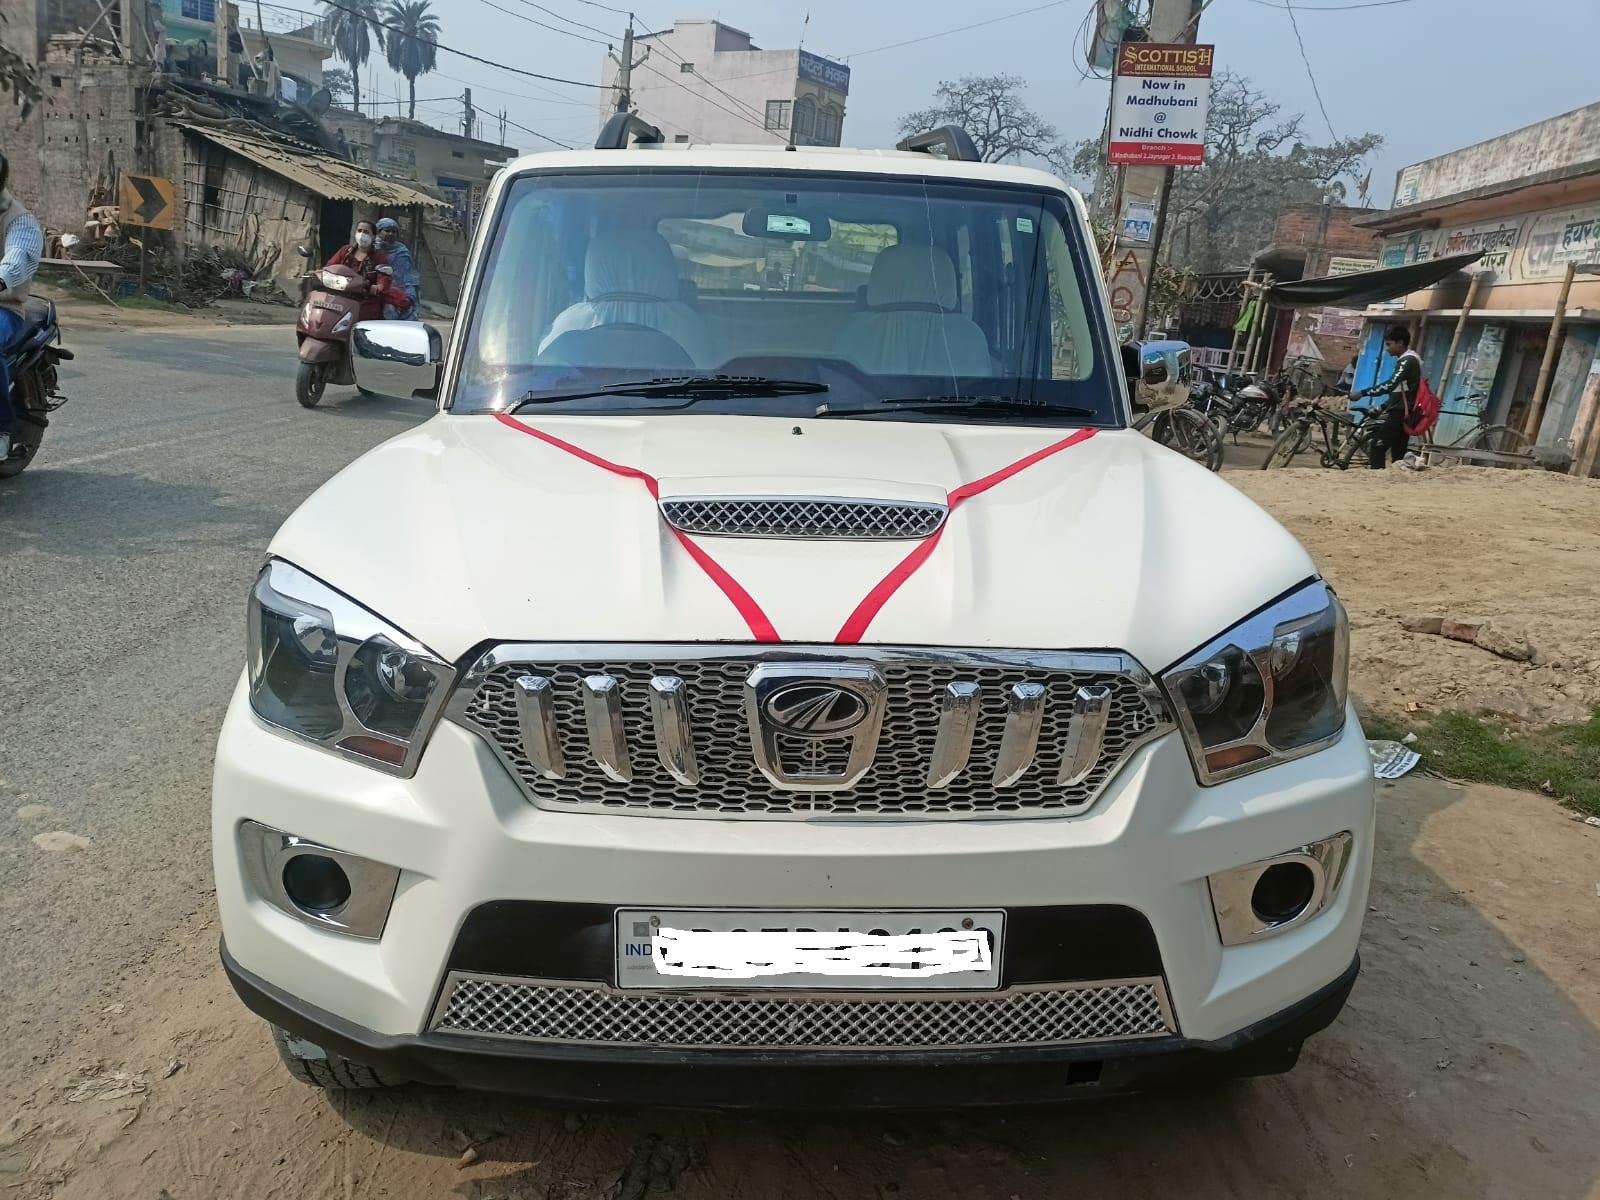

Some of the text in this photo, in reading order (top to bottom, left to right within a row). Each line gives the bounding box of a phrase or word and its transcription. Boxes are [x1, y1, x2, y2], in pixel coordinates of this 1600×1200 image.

[1124, 46, 1212, 65] SCOTTISH
[1135, 64, 1197, 72] INTERNATIONAL SCHOOL
[1142, 79, 1186, 91] Now in
[1126, 95, 1198, 107] Madhubani
[1153, 112, 1167, 123] @
[1119, 127, 1198, 139] Nidhi Chowk
[625, 943, 653, 956] IND
